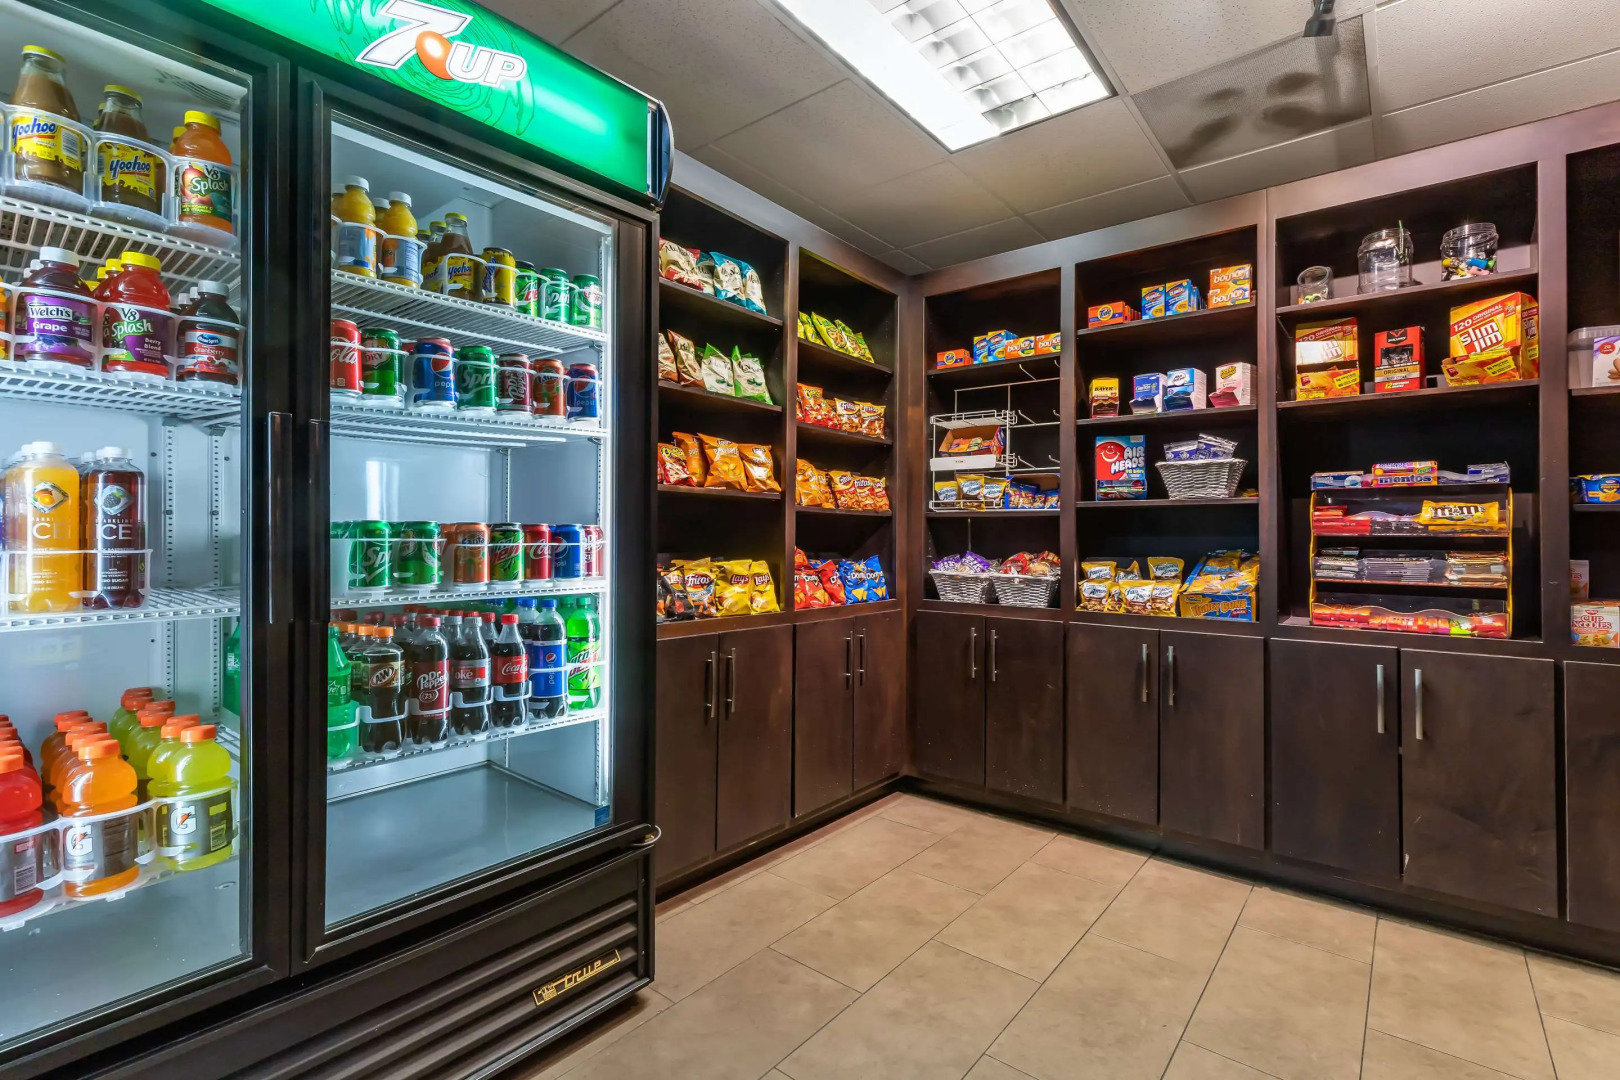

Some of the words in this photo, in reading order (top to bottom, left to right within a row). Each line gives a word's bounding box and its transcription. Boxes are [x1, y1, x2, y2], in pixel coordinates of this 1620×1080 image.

[12, 117, 57, 148] yoohoo
[110, 156, 151, 180] yoohoo
[205, 166, 219, 180] V8
[190, 177, 229, 196] Splash
[29, 306, 71, 318] Welch's
[121, 307, 138, 321] V8
[1099, 309, 1111, 318] Tide
[1454, 319, 1472, 332] 120
[1472, 304, 1502, 320] ORIGINAL
[33, 321, 68, 332] Grape
[111, 319, 153, 339] Splash
[144, 337, 161, 346] Berry
[144, 343, 161, 351] Blend
[193, 346, 224, 356] Cranberry
[1124, 446, 1145, 460] AIR
[1111, 457, 1145, 474] HEADS
[1378, 474, 1432, 484] mentos
[686, 574, 711, 587] Fritos
[1581, 615, 1604, 624] CUP
[454, 669, 474, 679] oke
[170, 805, 197, 835] G
[66, 825, 93, 856] G
